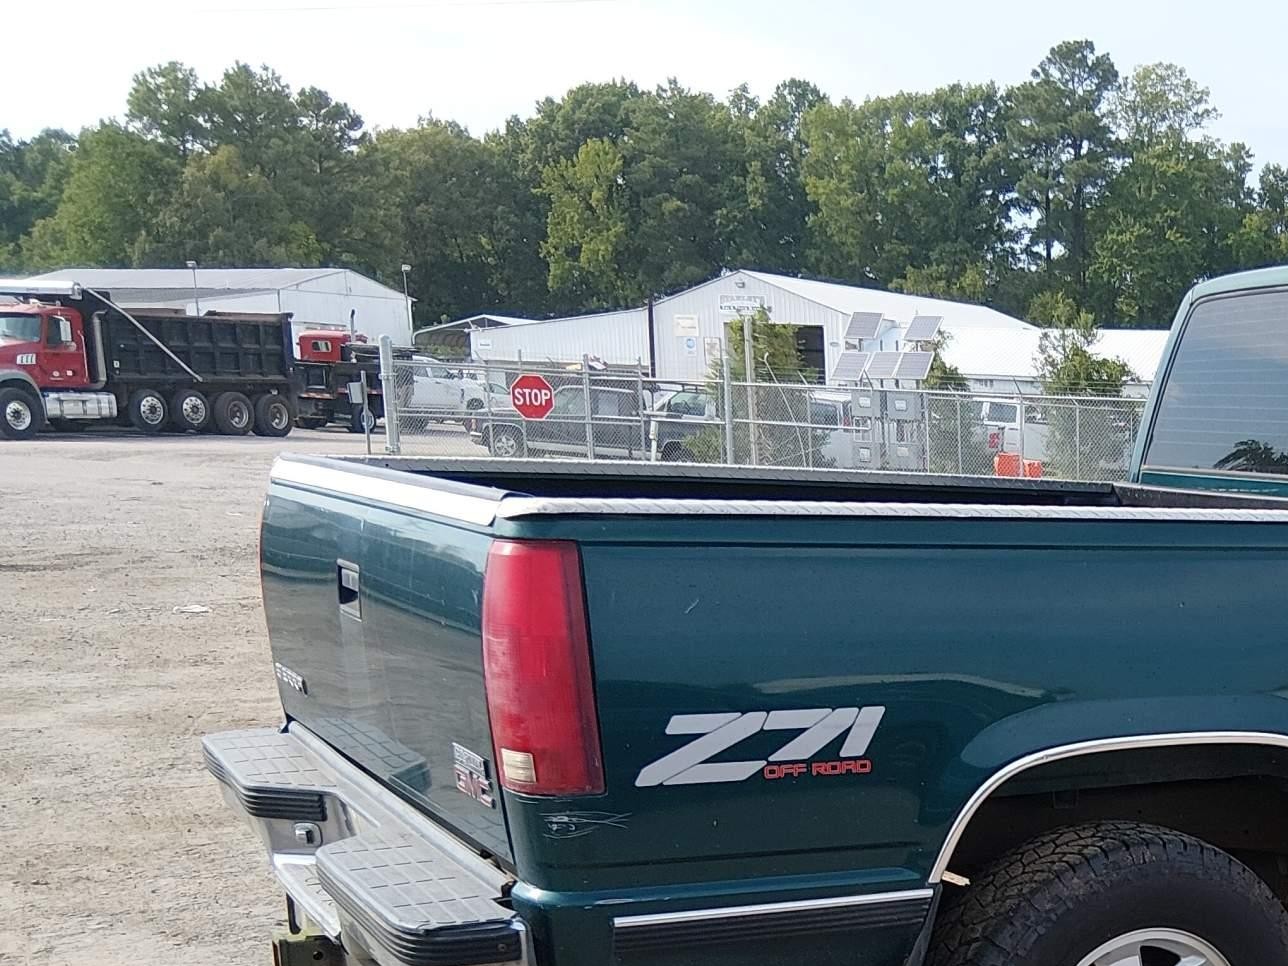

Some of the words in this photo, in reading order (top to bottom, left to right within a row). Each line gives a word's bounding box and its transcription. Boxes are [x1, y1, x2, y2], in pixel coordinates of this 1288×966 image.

[514, 388, 551, 406] STOP
[635, 706, 886, 787] Z71
[764, 763, 807, 779] OFF
[812, 760, 871, 776] ROAD
